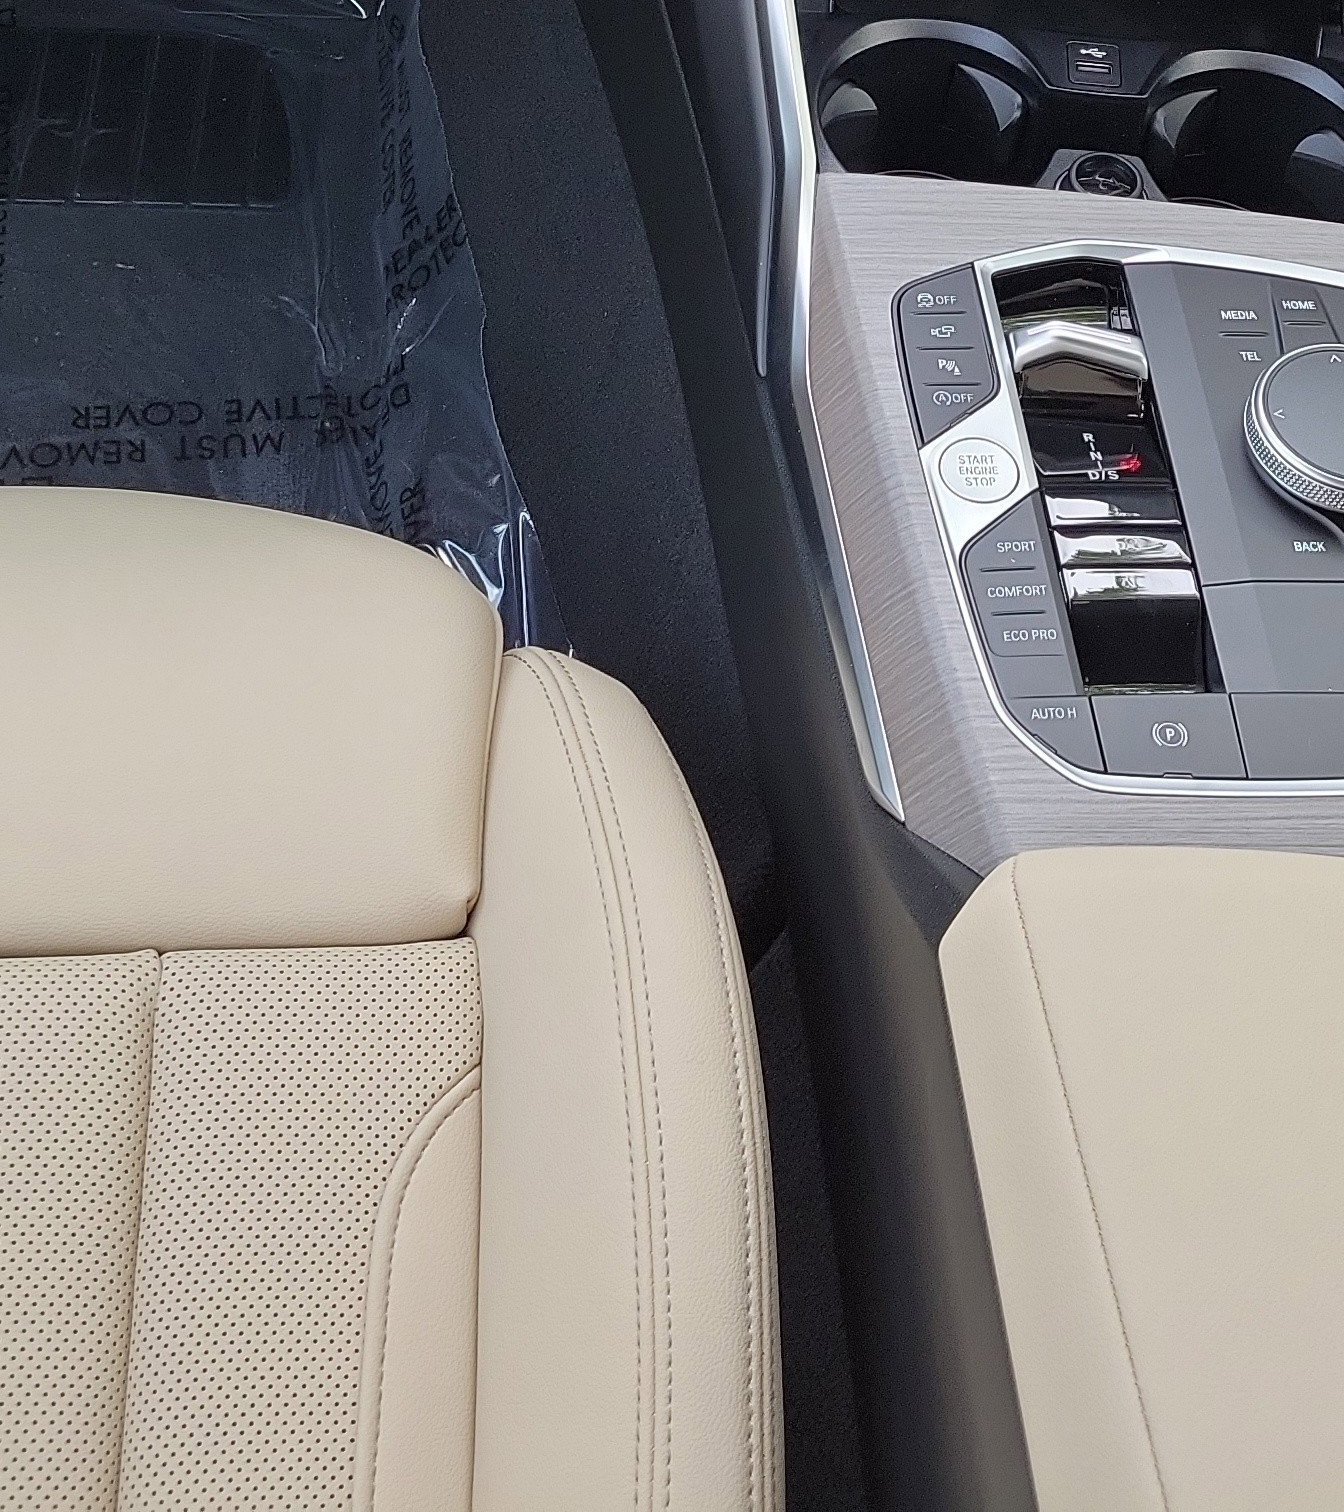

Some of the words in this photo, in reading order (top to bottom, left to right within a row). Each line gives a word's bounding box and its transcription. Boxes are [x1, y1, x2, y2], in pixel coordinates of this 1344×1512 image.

[935, 294, 957, 305] OFF
[1282, 300, 1317, 310] HOME
[1221, 310, 1258, 321] MEDIA
[1239, 351, 1261, 361] TEL
[952, 392, 974, 404] OFF
[69, 399, 206, 430] COVER
[1082, 433, 1095, 443] R
[172, 431, 286, 461] MUST
[958, 455, 995, 465] START
[1090, 450, 1102, 460] N
[958, 465, 999, 476] ENGINE
[965, 475, 996, 486] STOP
[996, 540, 1036, 552] SPORT
[1293, 541, 1326, 553] BACK
[987, 585, 1047, 598] COMFORT
[1003, 630, 1029, 642] ECO
[1030, 629, 1056, 641] PRO
[1031, 707, 1064, 720] AUTO
[1066, 707, 1077, 719] H
